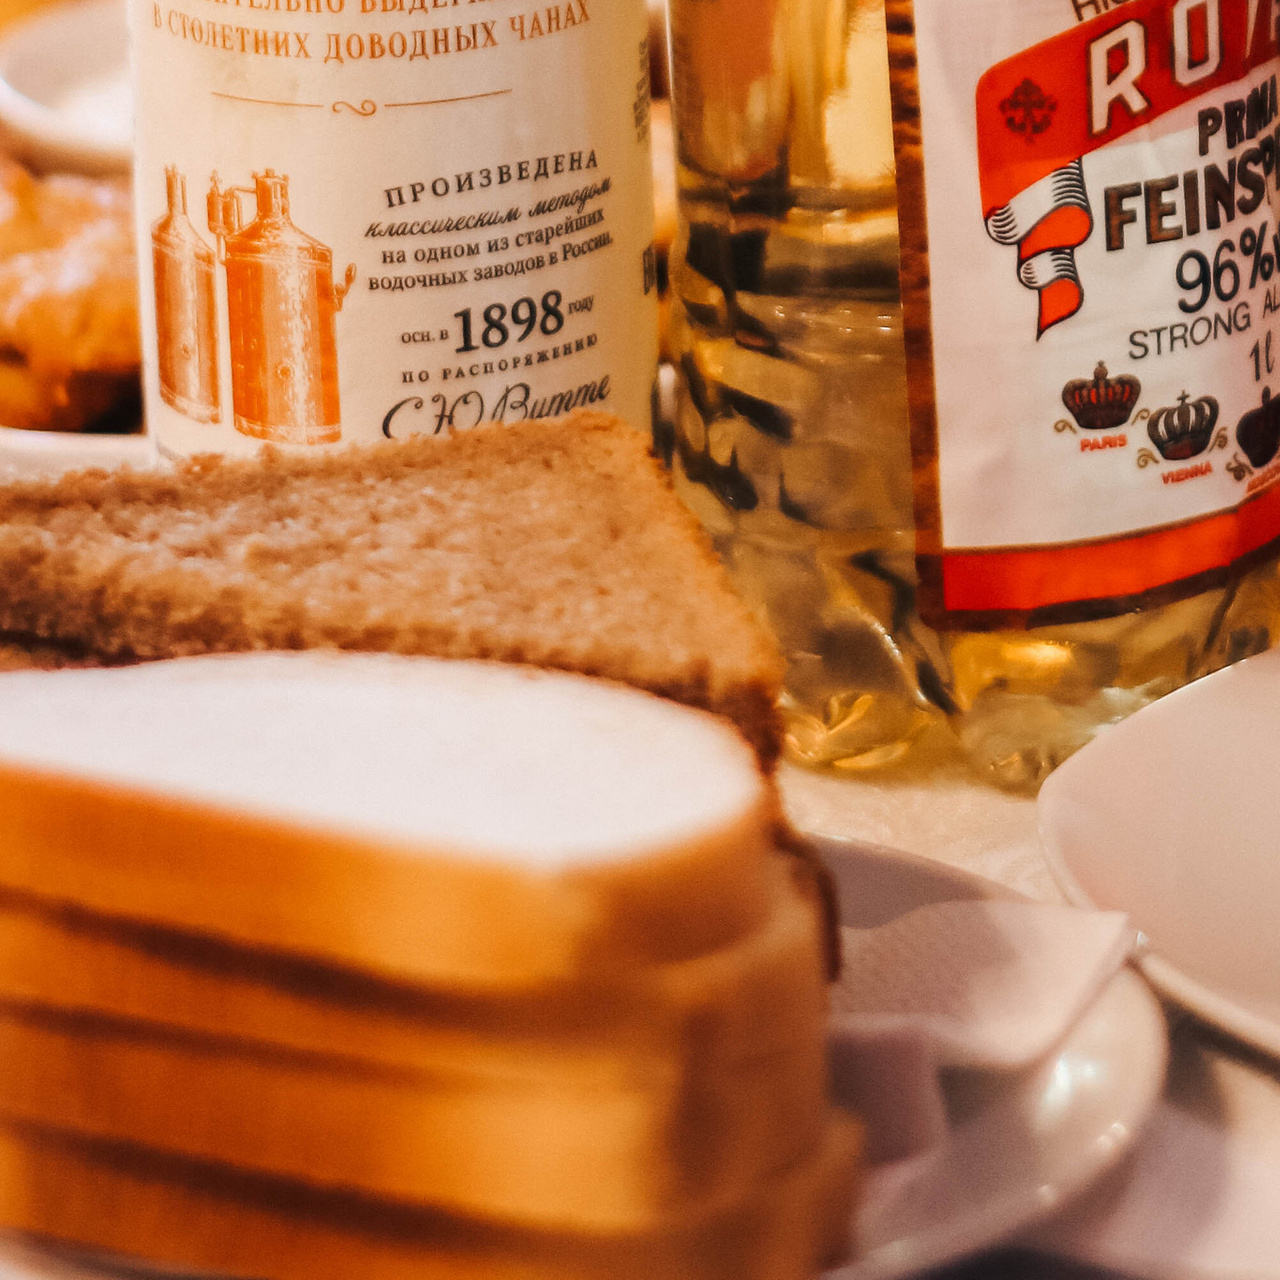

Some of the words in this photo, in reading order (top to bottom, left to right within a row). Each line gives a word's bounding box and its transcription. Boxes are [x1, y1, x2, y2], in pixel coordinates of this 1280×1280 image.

[153, 1, 163, 29] В
[168, 8, 312, 60] СТОЛЕТНИХ
[323, 20, 499, 65] ДОВОДНЫХ
[384, 148, 599, 208] ПРОИЗВЕДЕНА
[365, 205, 522, 238] классическим
[382, 249, 406, 264] на
[413, 243, 481, 264] одном
[487, 237, 508, 256] из
[515, 208, 605, 248] старейших
[368, 269, 469, 292] водочных
[473, 255, 545, 282] заводов
[454, 289, 565, 354] 1898
[1128, 300, 1252, 361] STRONG
[402, 370, 430, 384] ПО
[442, 332, 598, 381] РАСПОРЯЖЕНИЮ
[1080, 434, 1128, 453] PARIS
